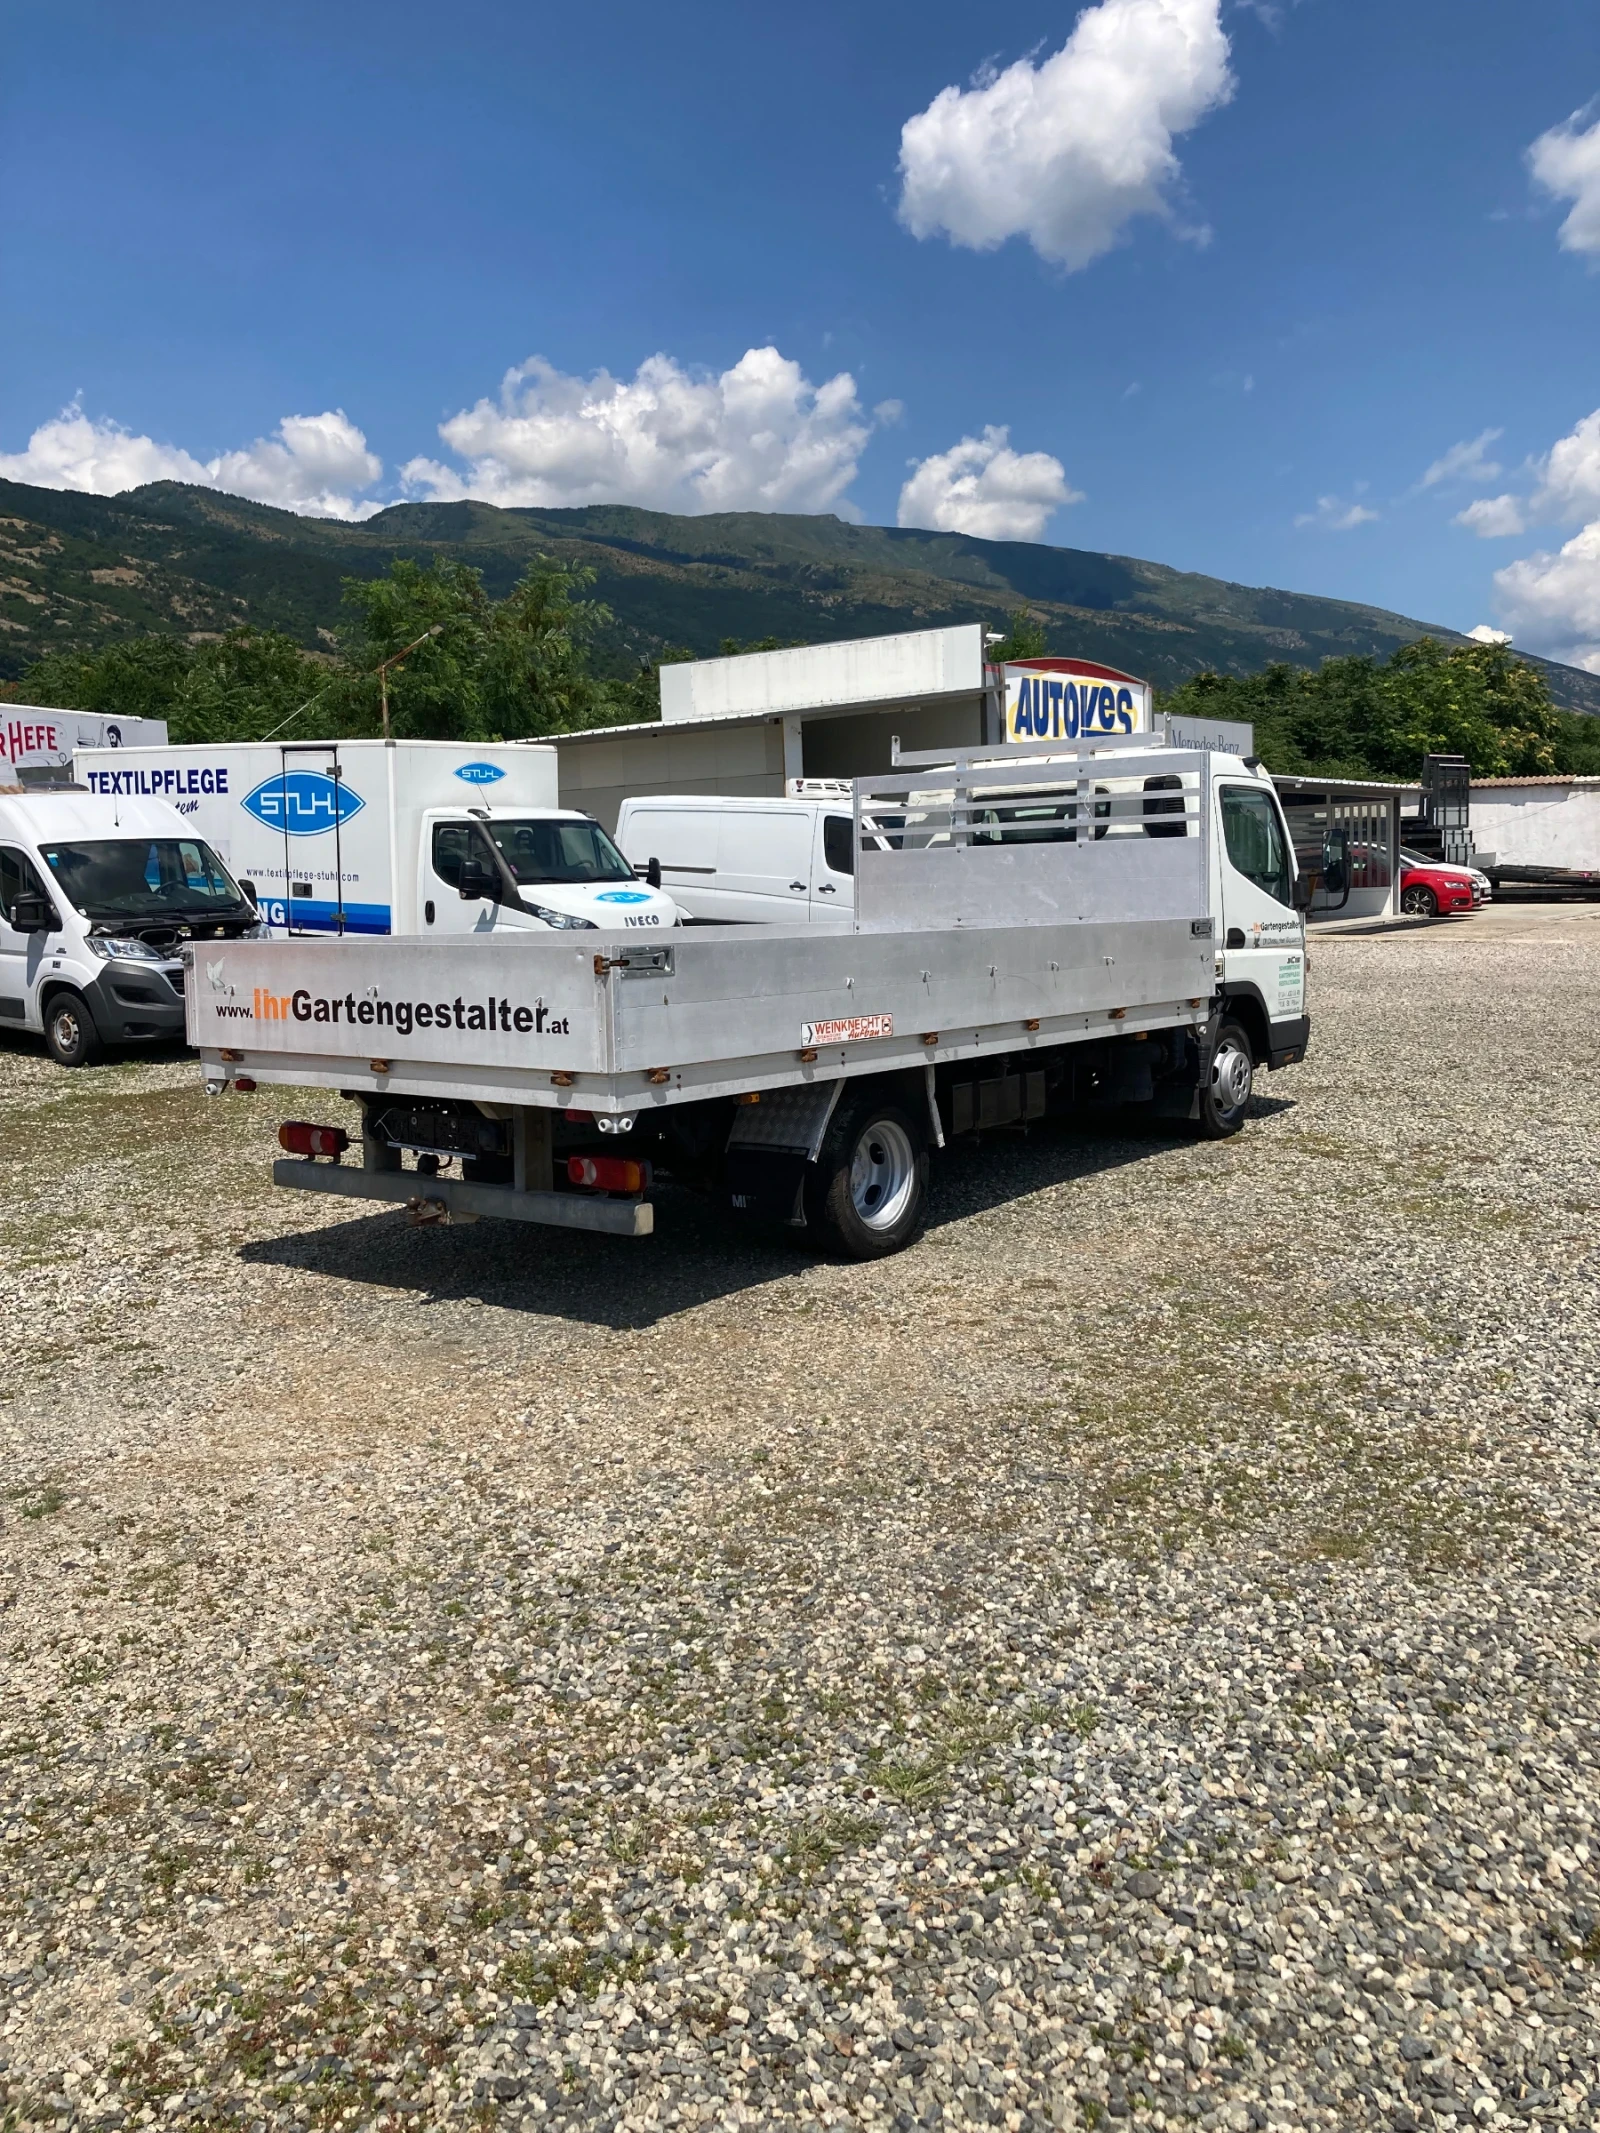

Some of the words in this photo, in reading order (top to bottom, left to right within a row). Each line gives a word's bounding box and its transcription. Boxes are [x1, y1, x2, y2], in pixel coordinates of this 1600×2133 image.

[87, 768, 229, 795] TEXTILPFLEGE
[624, 914, 660, 928] IVECO
[215, 988, 570, 1035] www.IhrGartengestalter.at
[814, 1016, 880, 1035] WEINKNECHT
[847, 1027, 880, 1039] Aufbau
